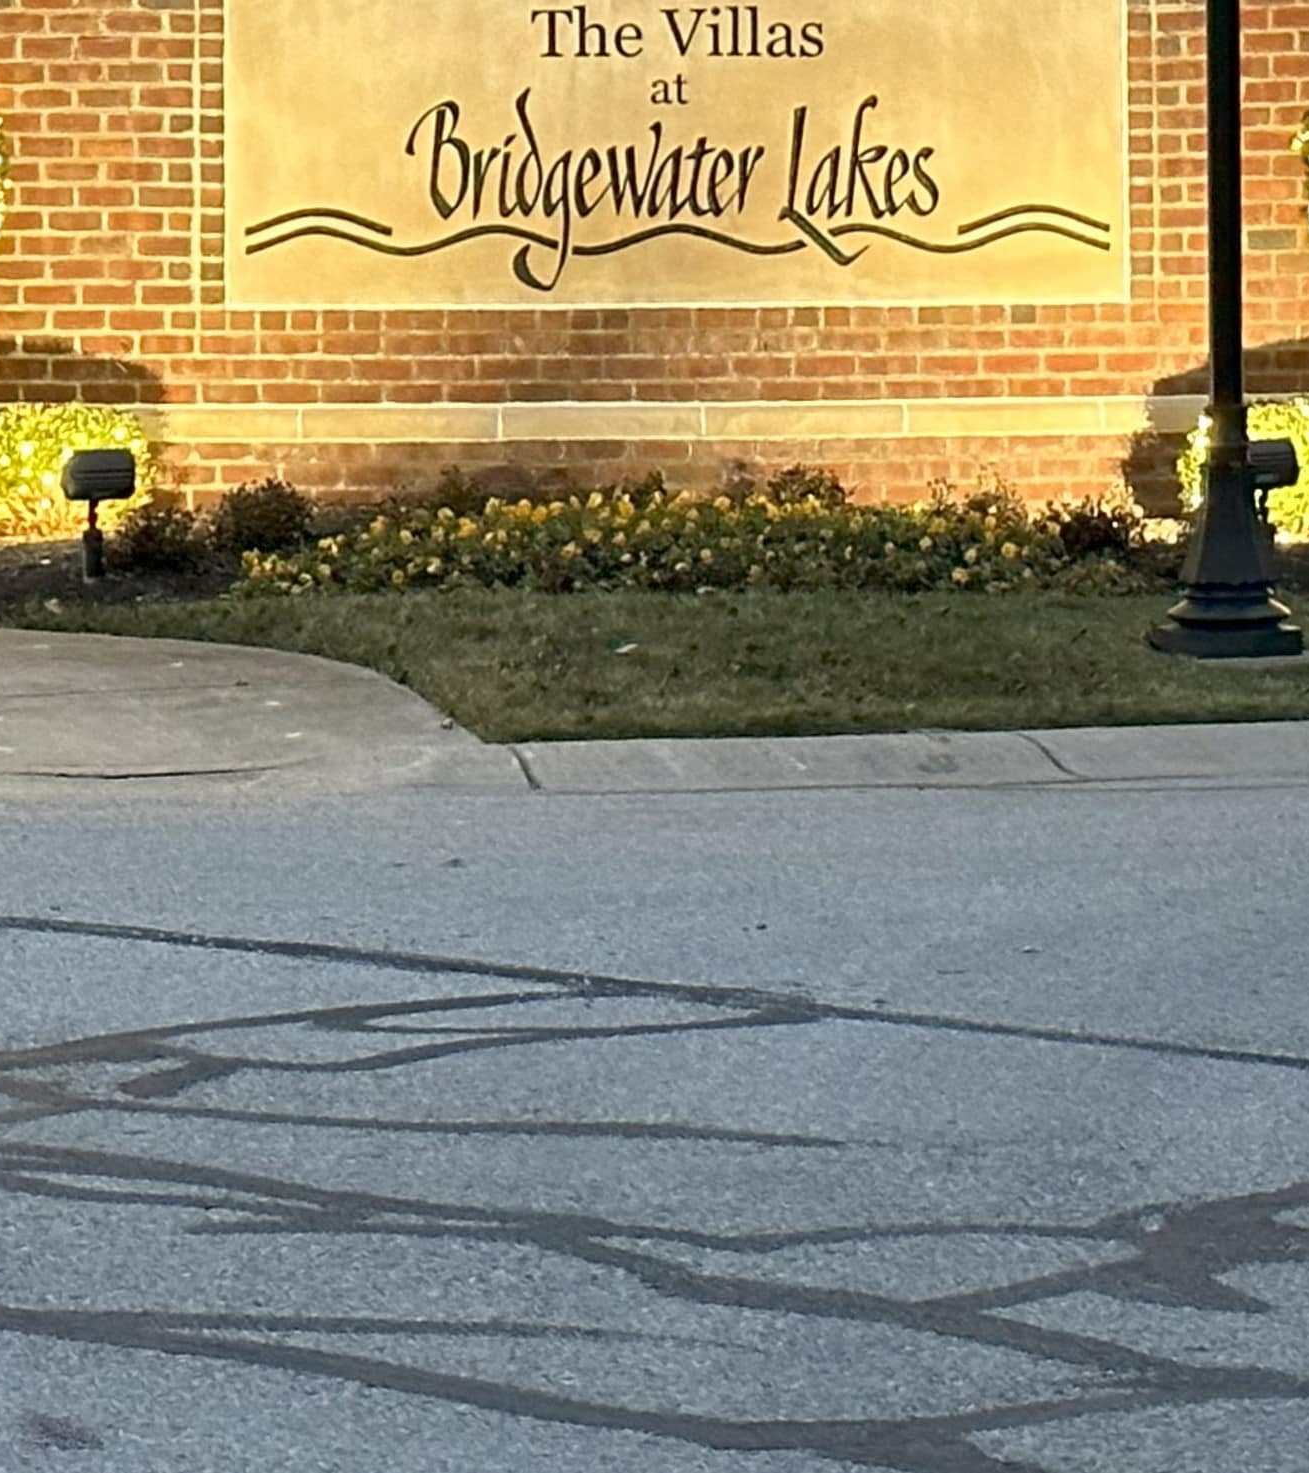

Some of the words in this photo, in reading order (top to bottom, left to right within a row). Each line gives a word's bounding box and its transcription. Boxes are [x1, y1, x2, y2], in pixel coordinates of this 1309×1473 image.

[531, 5, 643, 58] The
[661, 5, 825, 58] Villas
[650, 73, 689, 106] at
[405, 88, 765, 290] Bridgewater
[778, 95, 940, 266] Lakes
